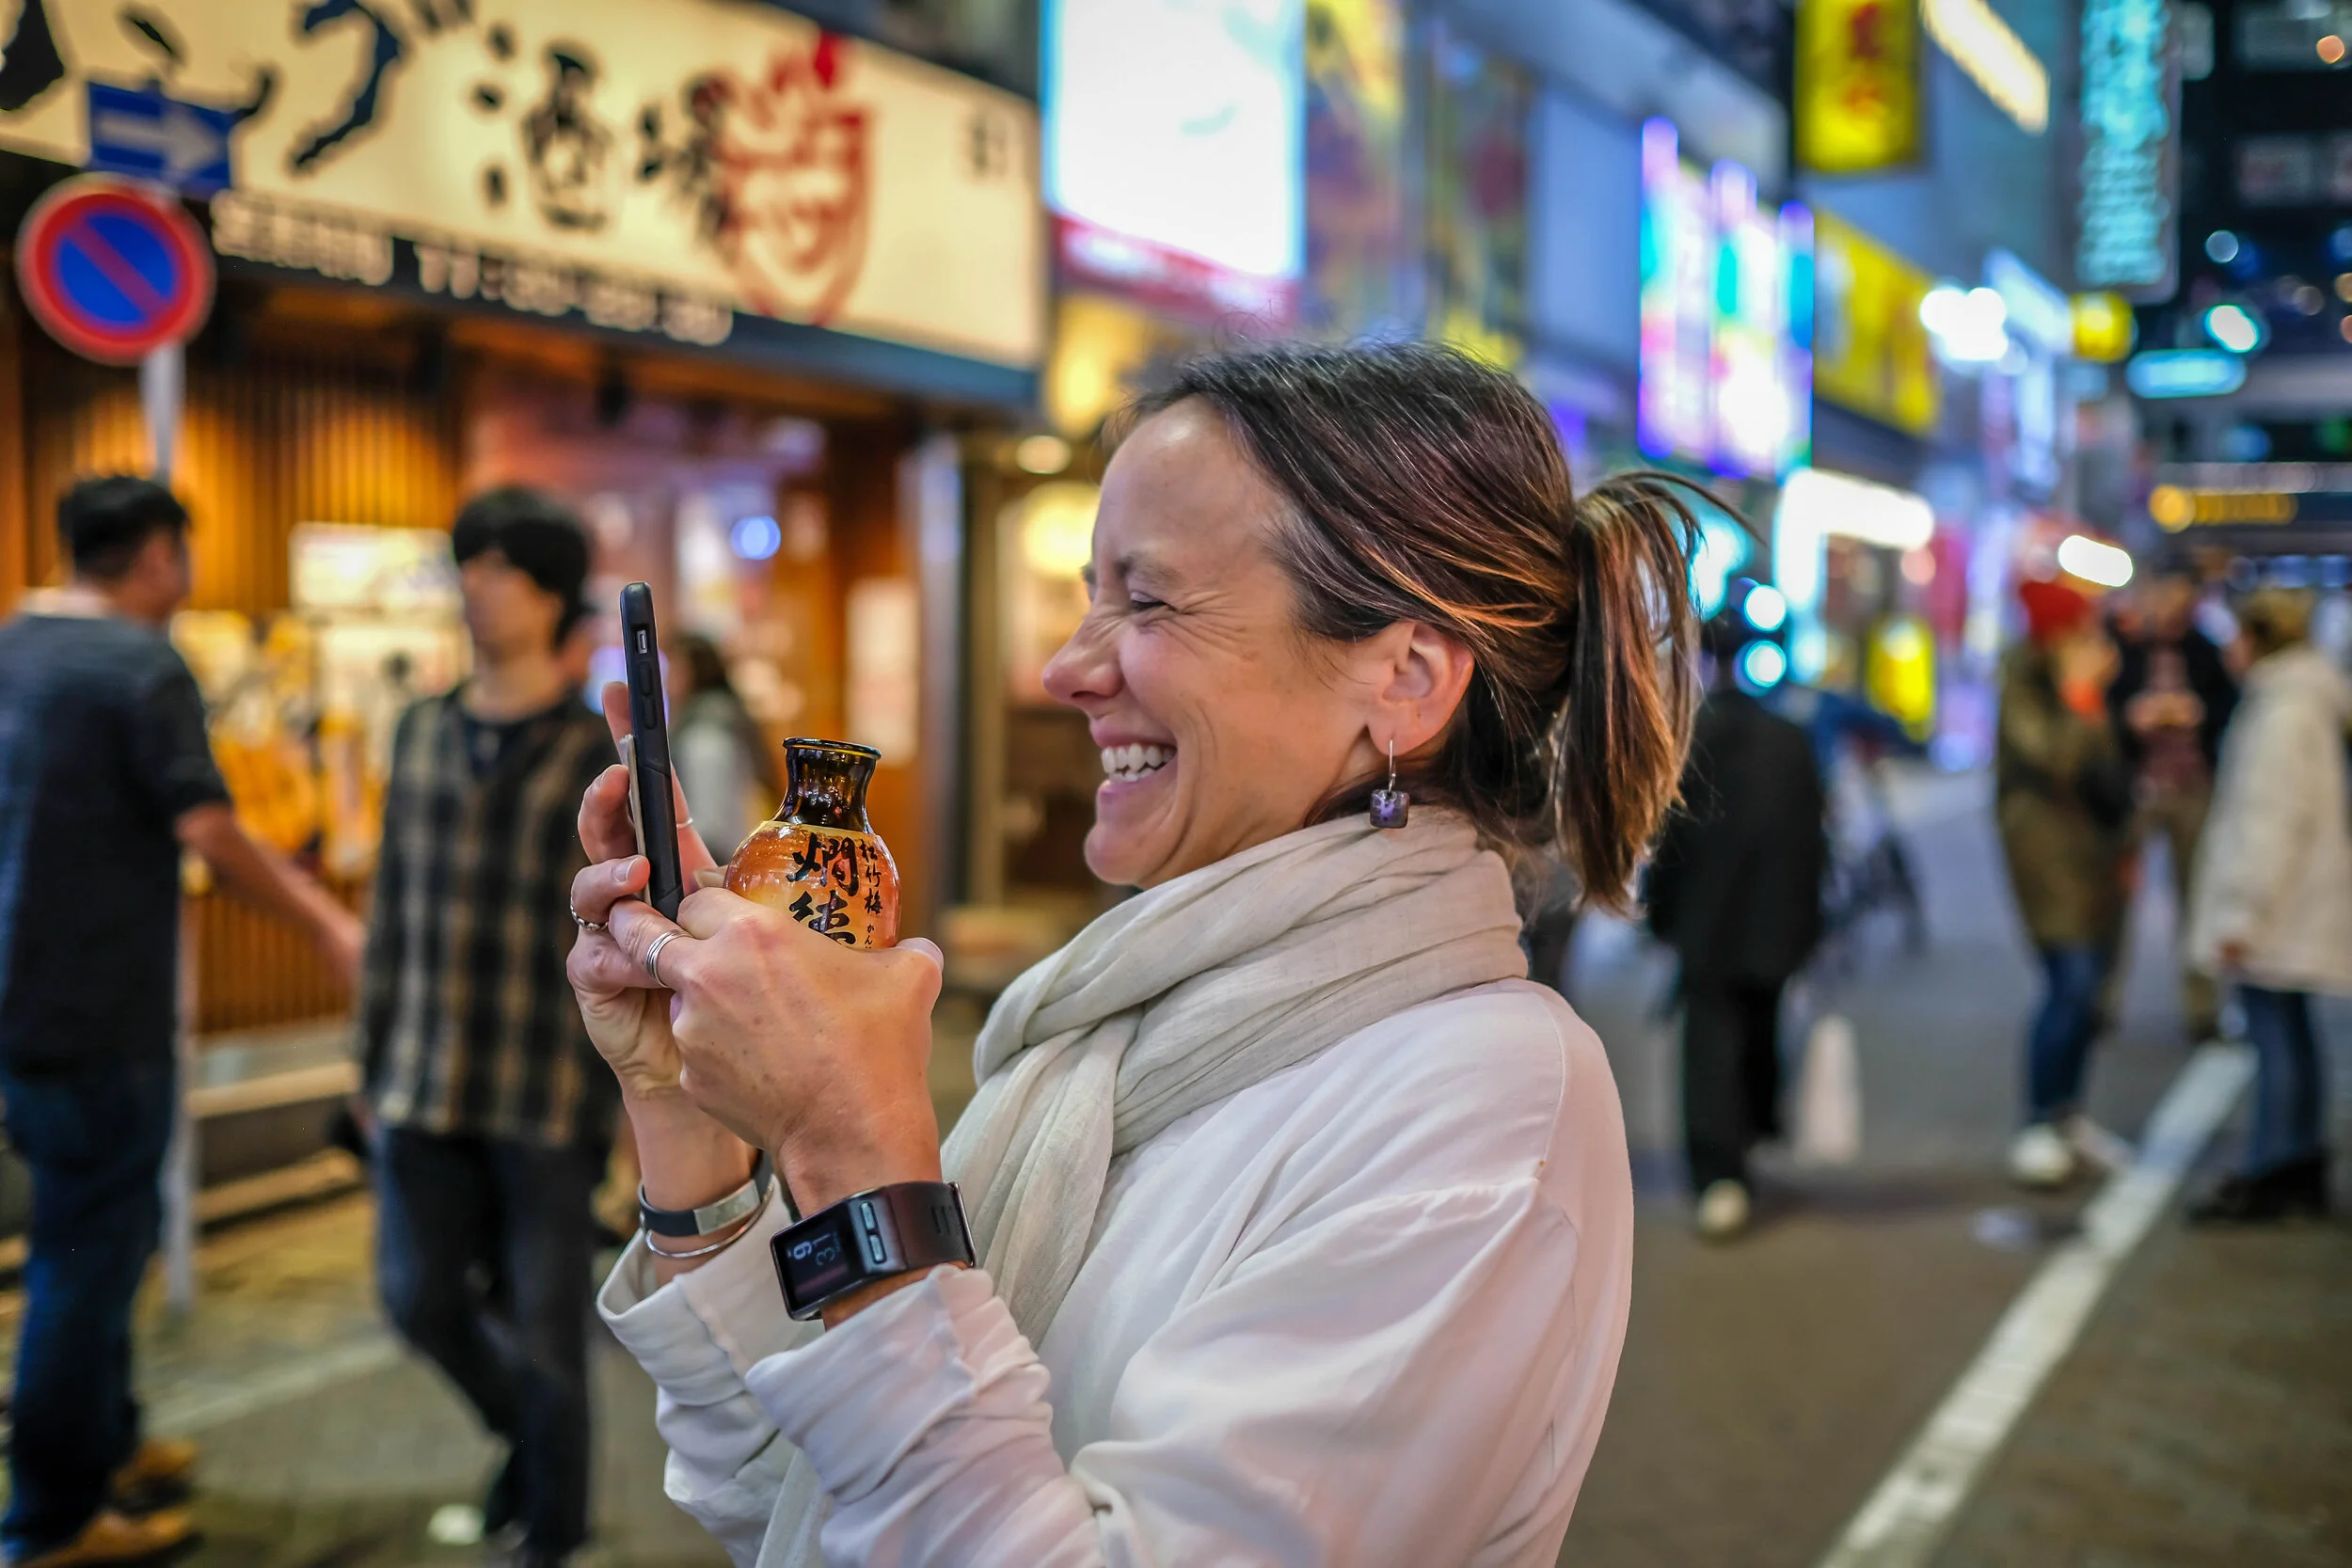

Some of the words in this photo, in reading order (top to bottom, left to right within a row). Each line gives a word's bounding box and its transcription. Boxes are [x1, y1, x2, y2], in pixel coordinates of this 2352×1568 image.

[860, 838, 882, 914] 松竹梅
[865, 924, 875, 948] かん
